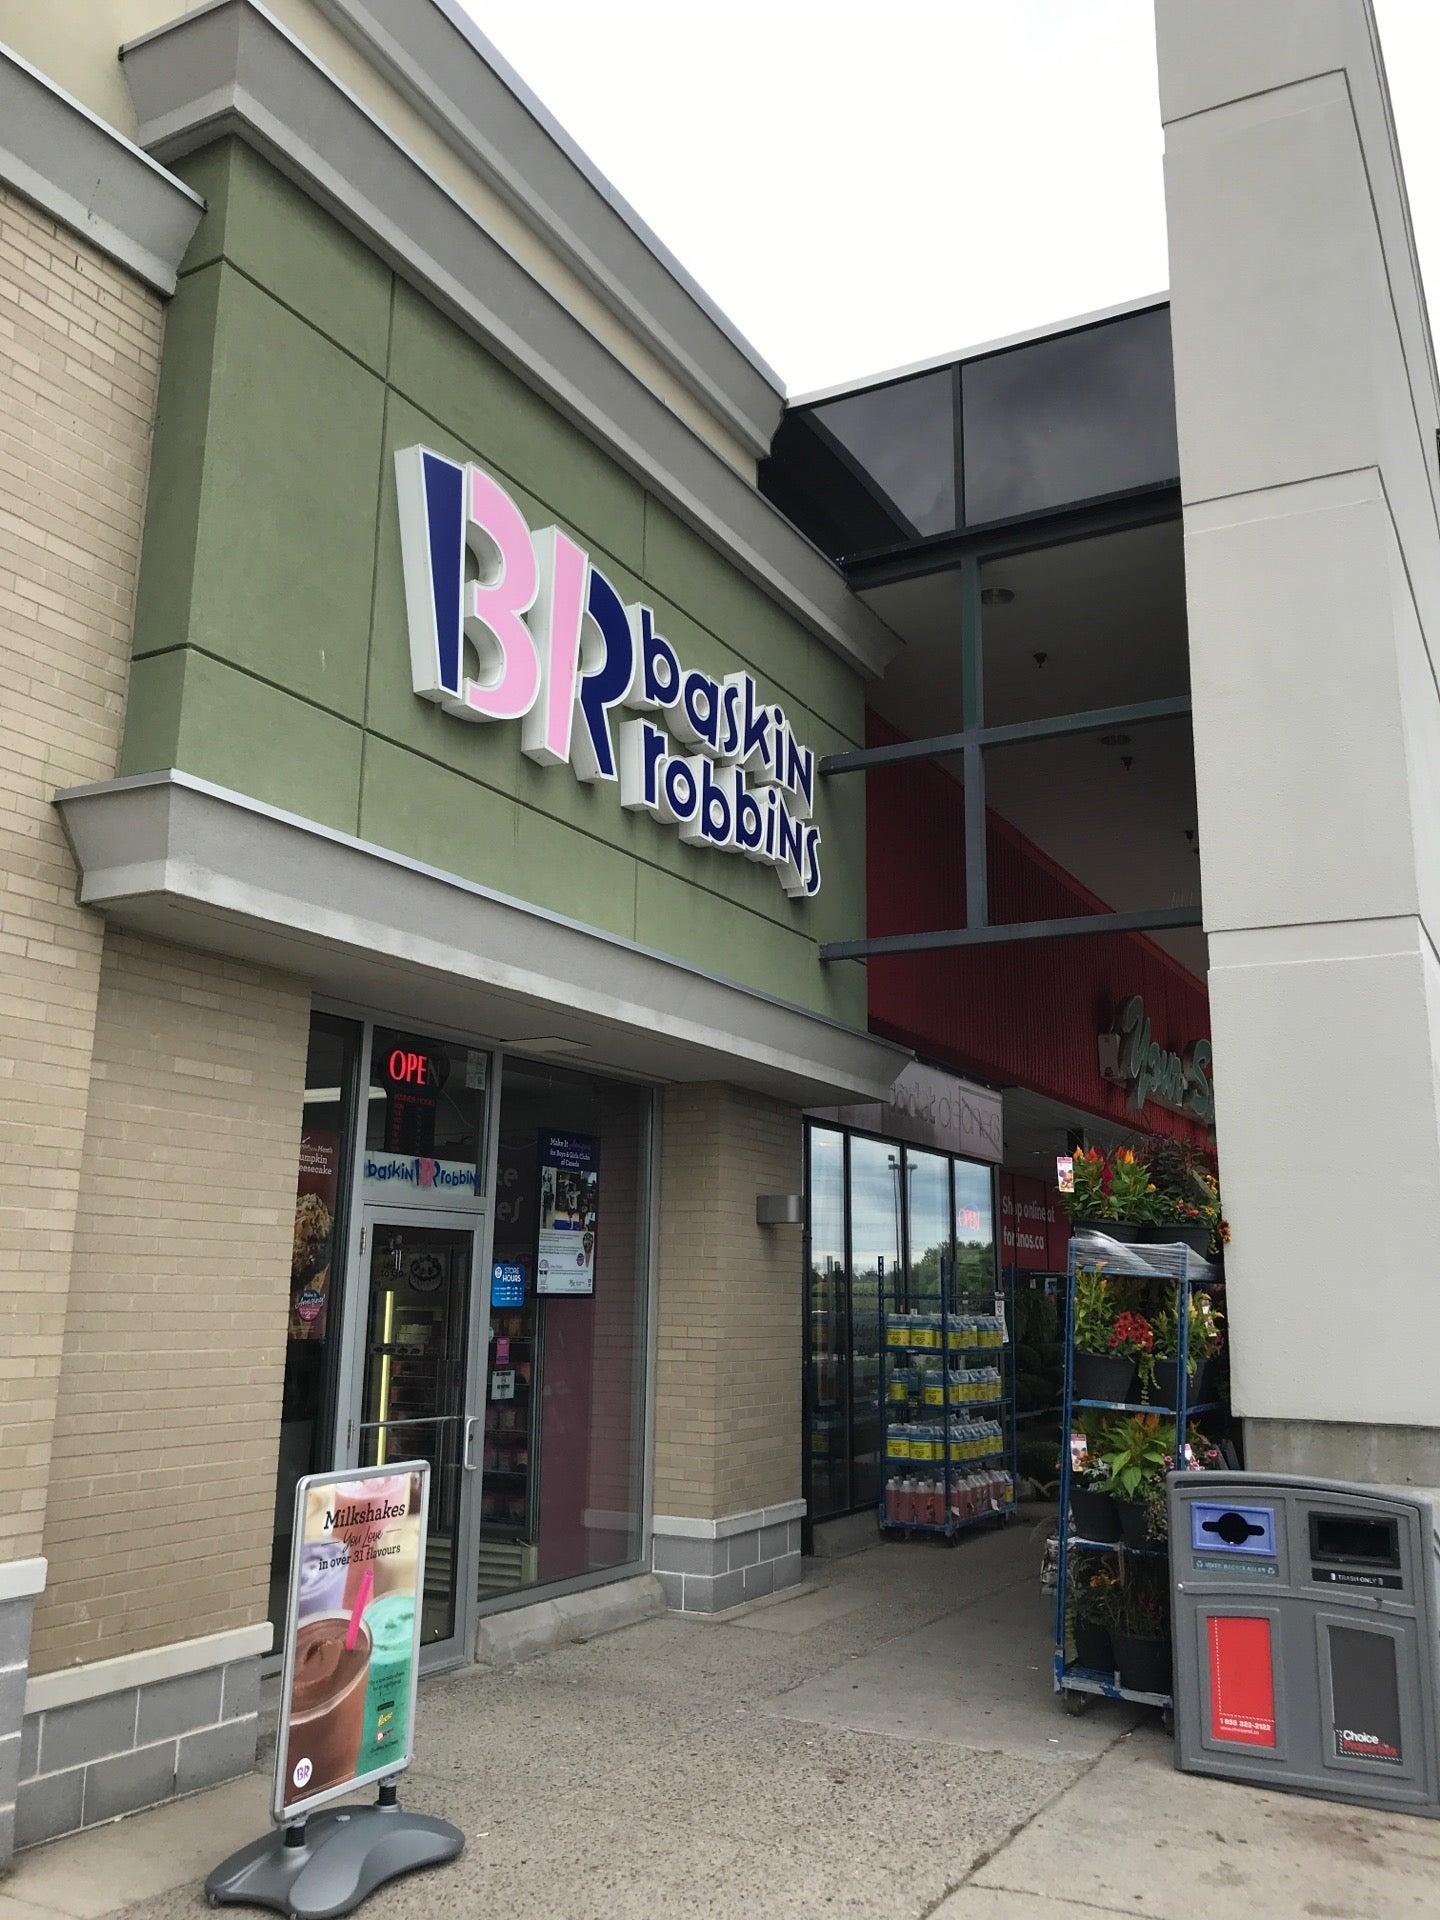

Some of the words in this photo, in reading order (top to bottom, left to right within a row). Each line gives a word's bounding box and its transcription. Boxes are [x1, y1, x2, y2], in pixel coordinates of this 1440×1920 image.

[300, 1153, 328, 1164] umpkin
[300, 1164, 332, 1175] eesecake
[323, 1499, 406, 1530] Milkshakes
[319, 1558, 329, 1571] in
[330, 1555, 352, 1568] over
[353, 1549, 363, 1563] 31
[366, 1544, 401, 1561] flavours
[1338, 1574, 1359, 1582] TRASH
[1343, 1729, 1379, 1745] Choice
